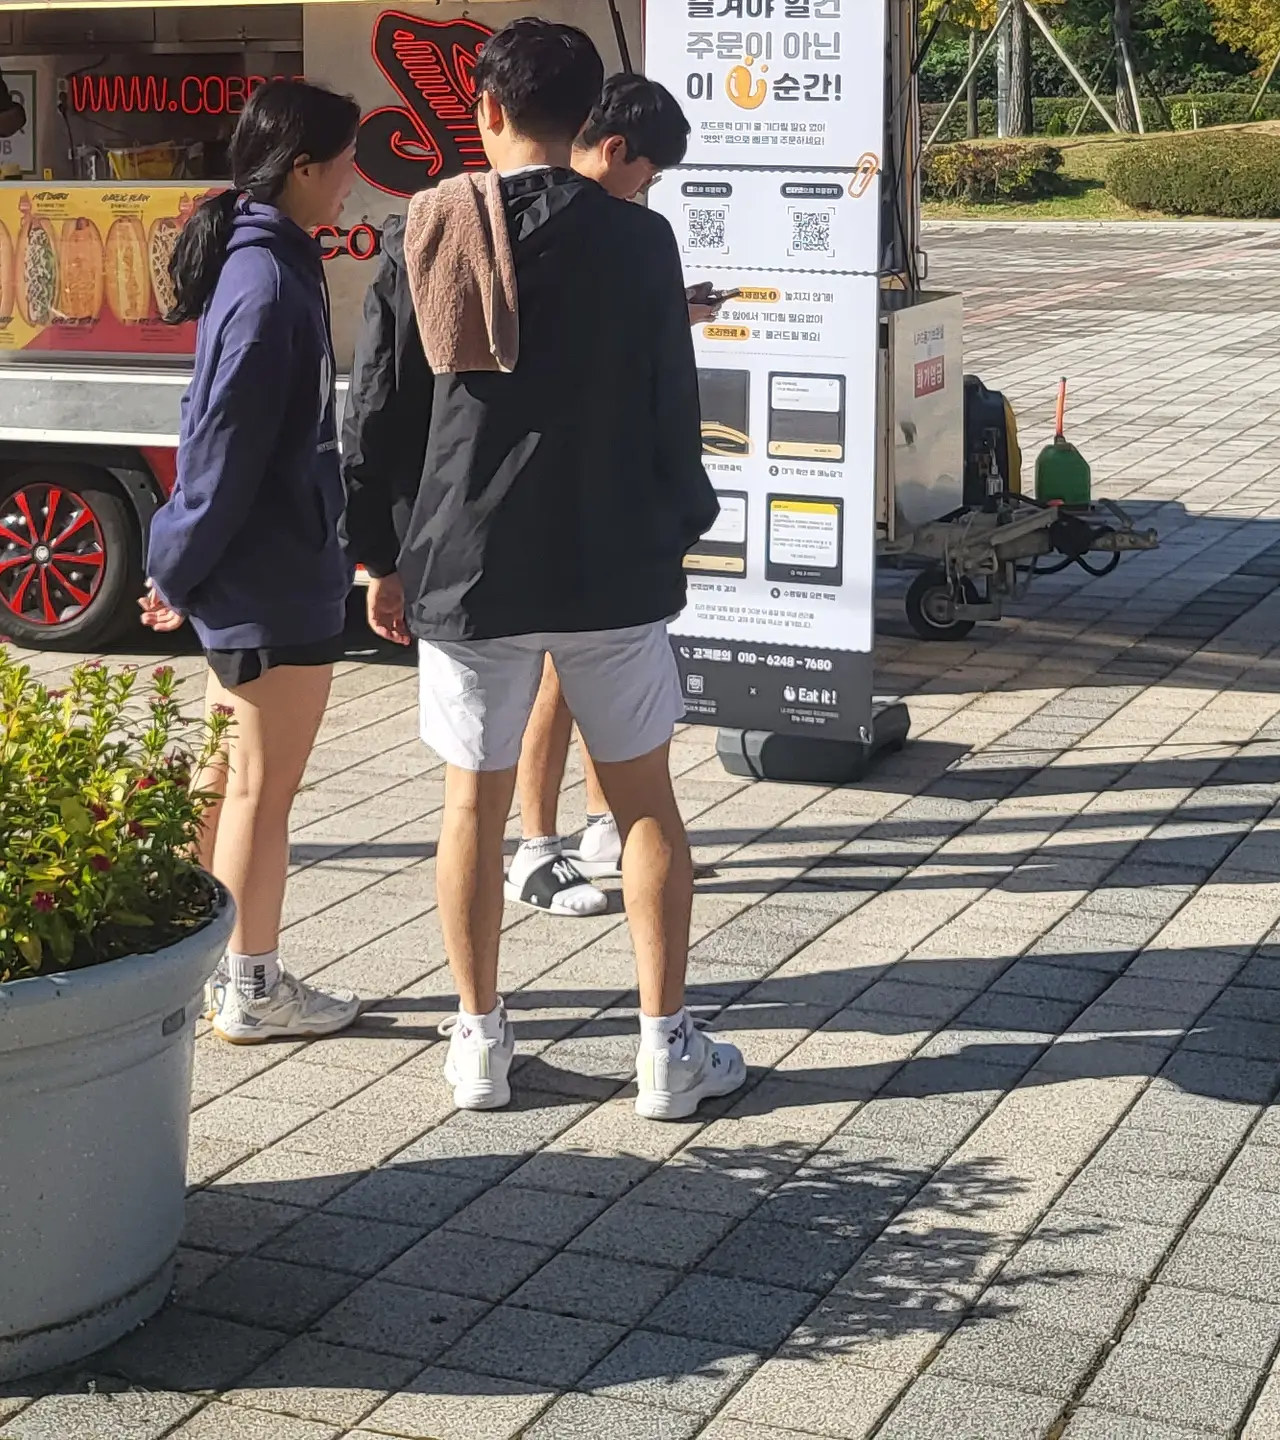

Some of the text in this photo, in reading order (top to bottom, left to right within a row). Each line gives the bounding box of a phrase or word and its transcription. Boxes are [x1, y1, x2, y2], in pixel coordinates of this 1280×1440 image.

[686, 31, 841, 60] 주문이 아닌
[686, 72, 841, 101] 이 순간!
[735, 122, 752, 131] 대기
[692, 647, 732, 662] 고객문의
[798, 687, 819, 704] Eat
